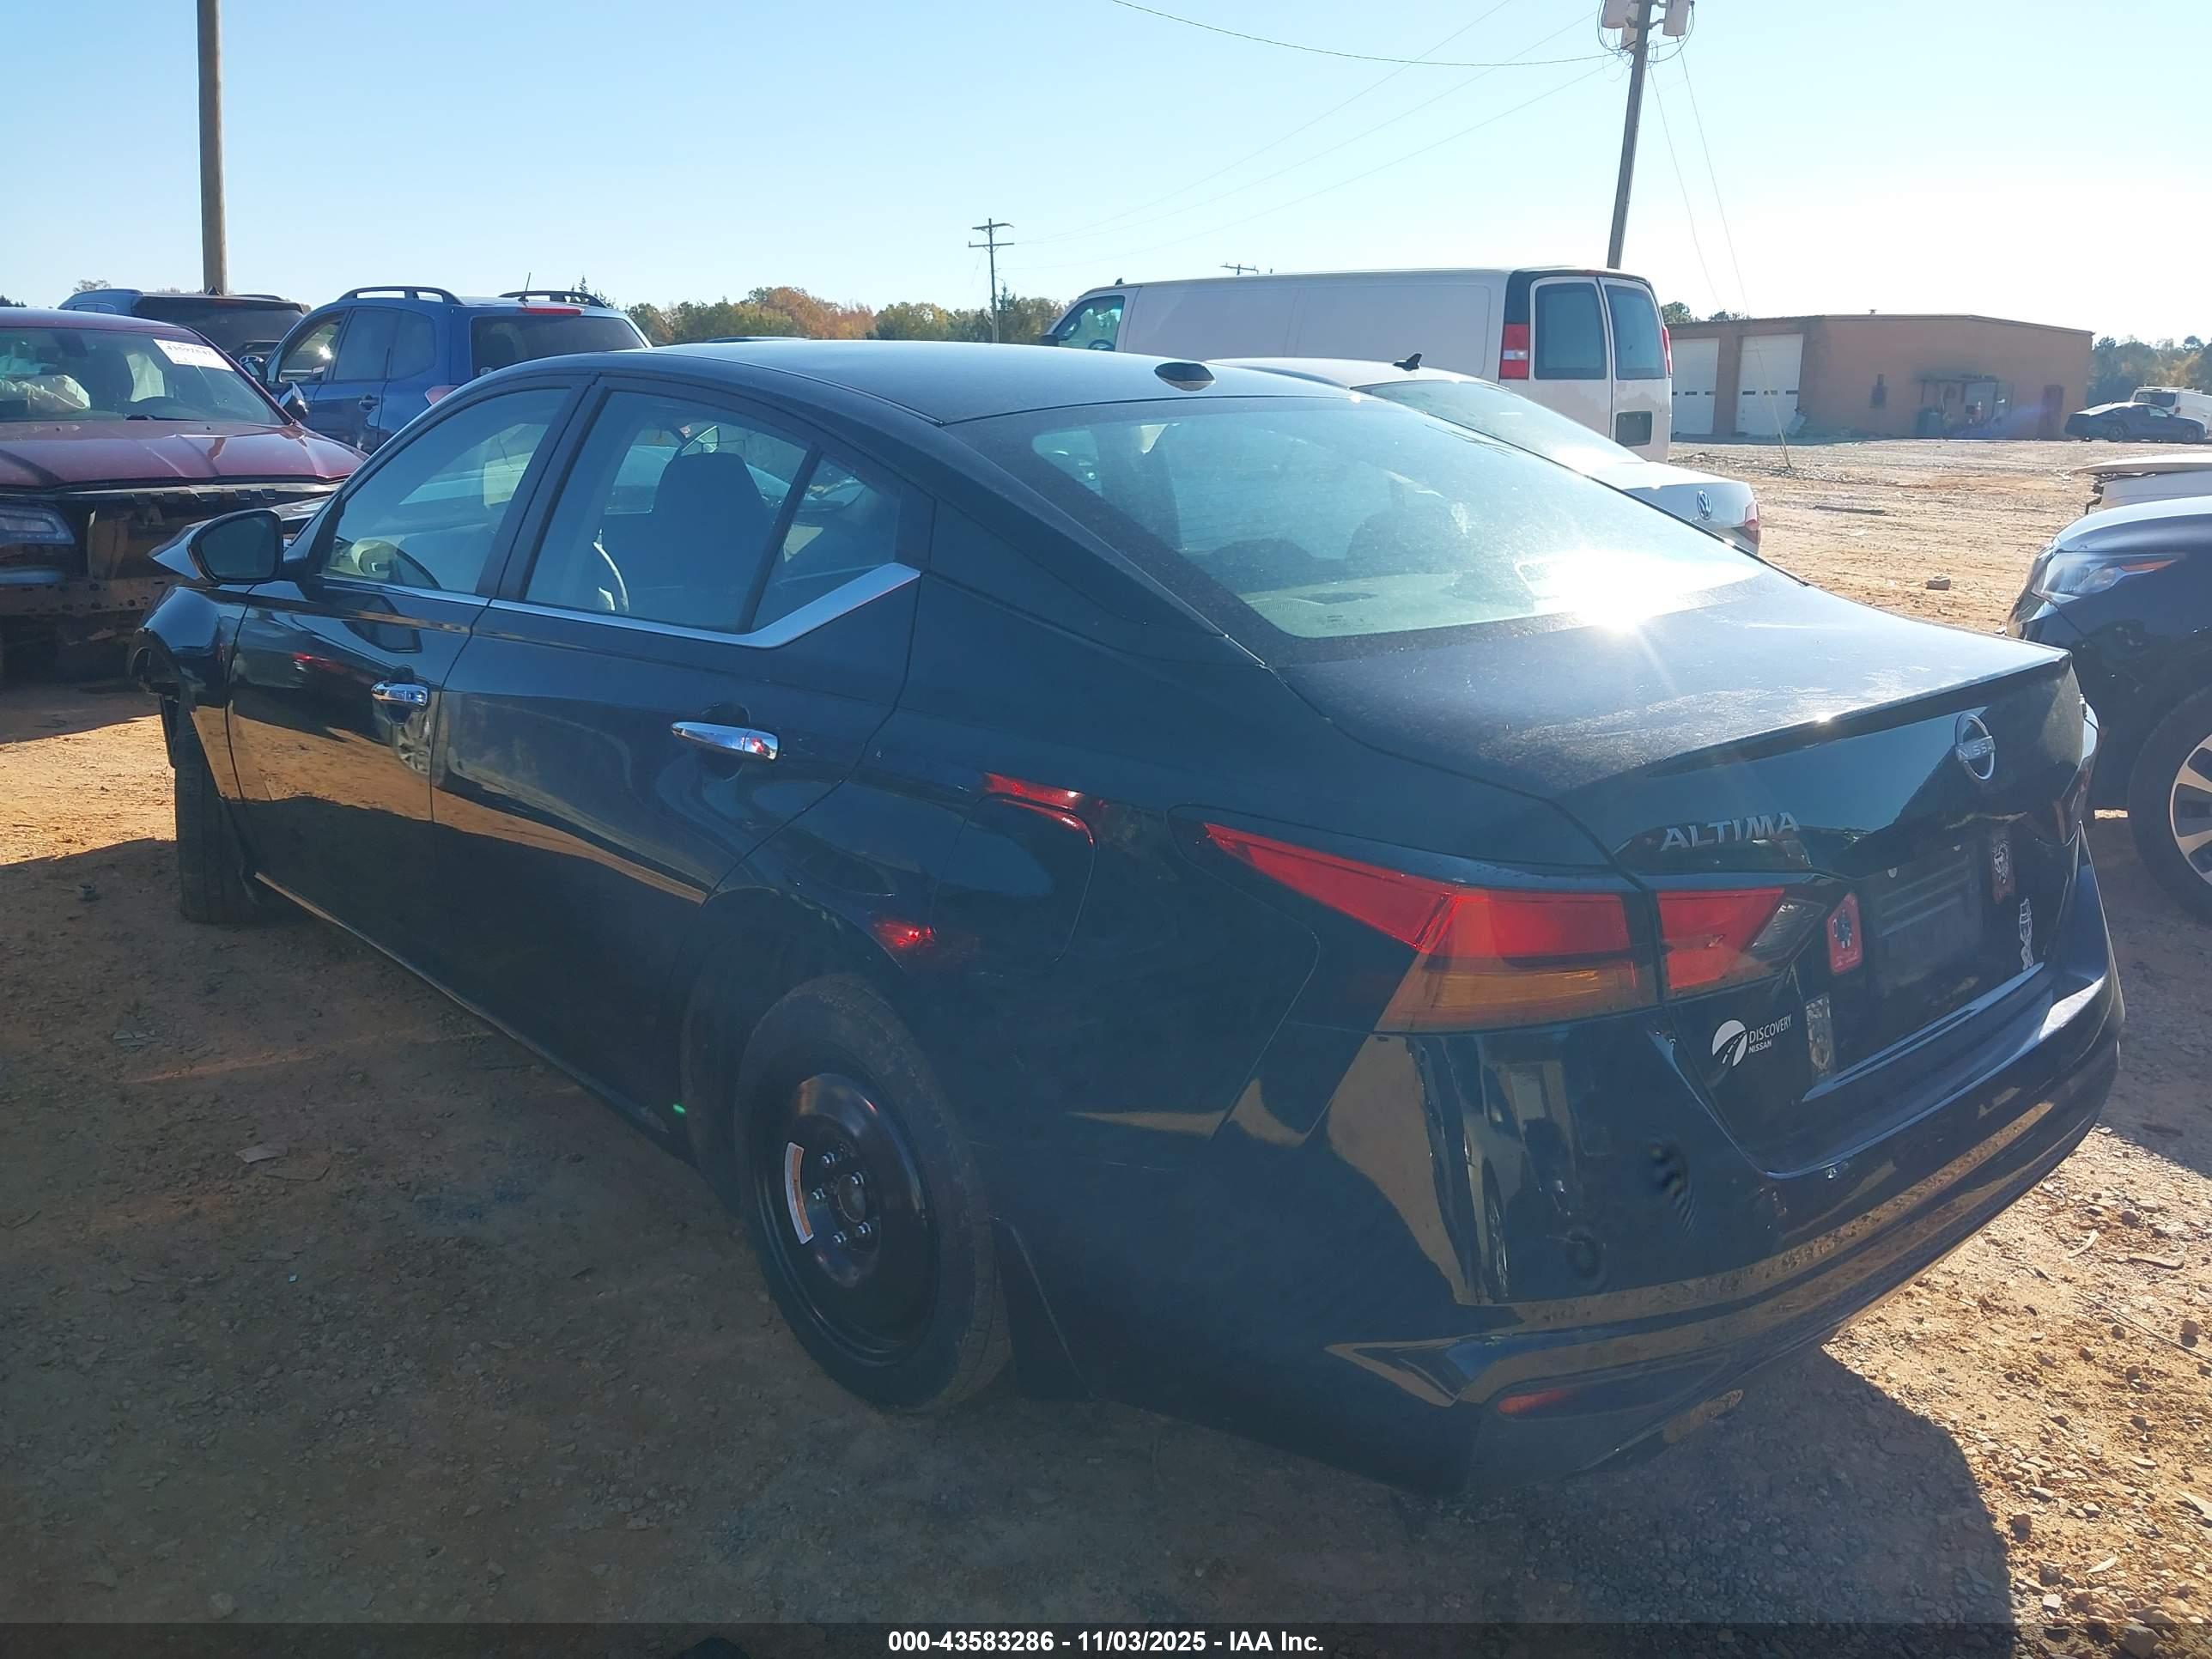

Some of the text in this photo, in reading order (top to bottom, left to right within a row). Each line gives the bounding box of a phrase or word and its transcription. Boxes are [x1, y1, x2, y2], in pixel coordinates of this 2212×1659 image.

[1660, 811, 1801, 851] ALTIMA
[1749, 1014, 1792, 1044] DISCOVERY
[1748, 1039, 1772, 1054] NISSAN
